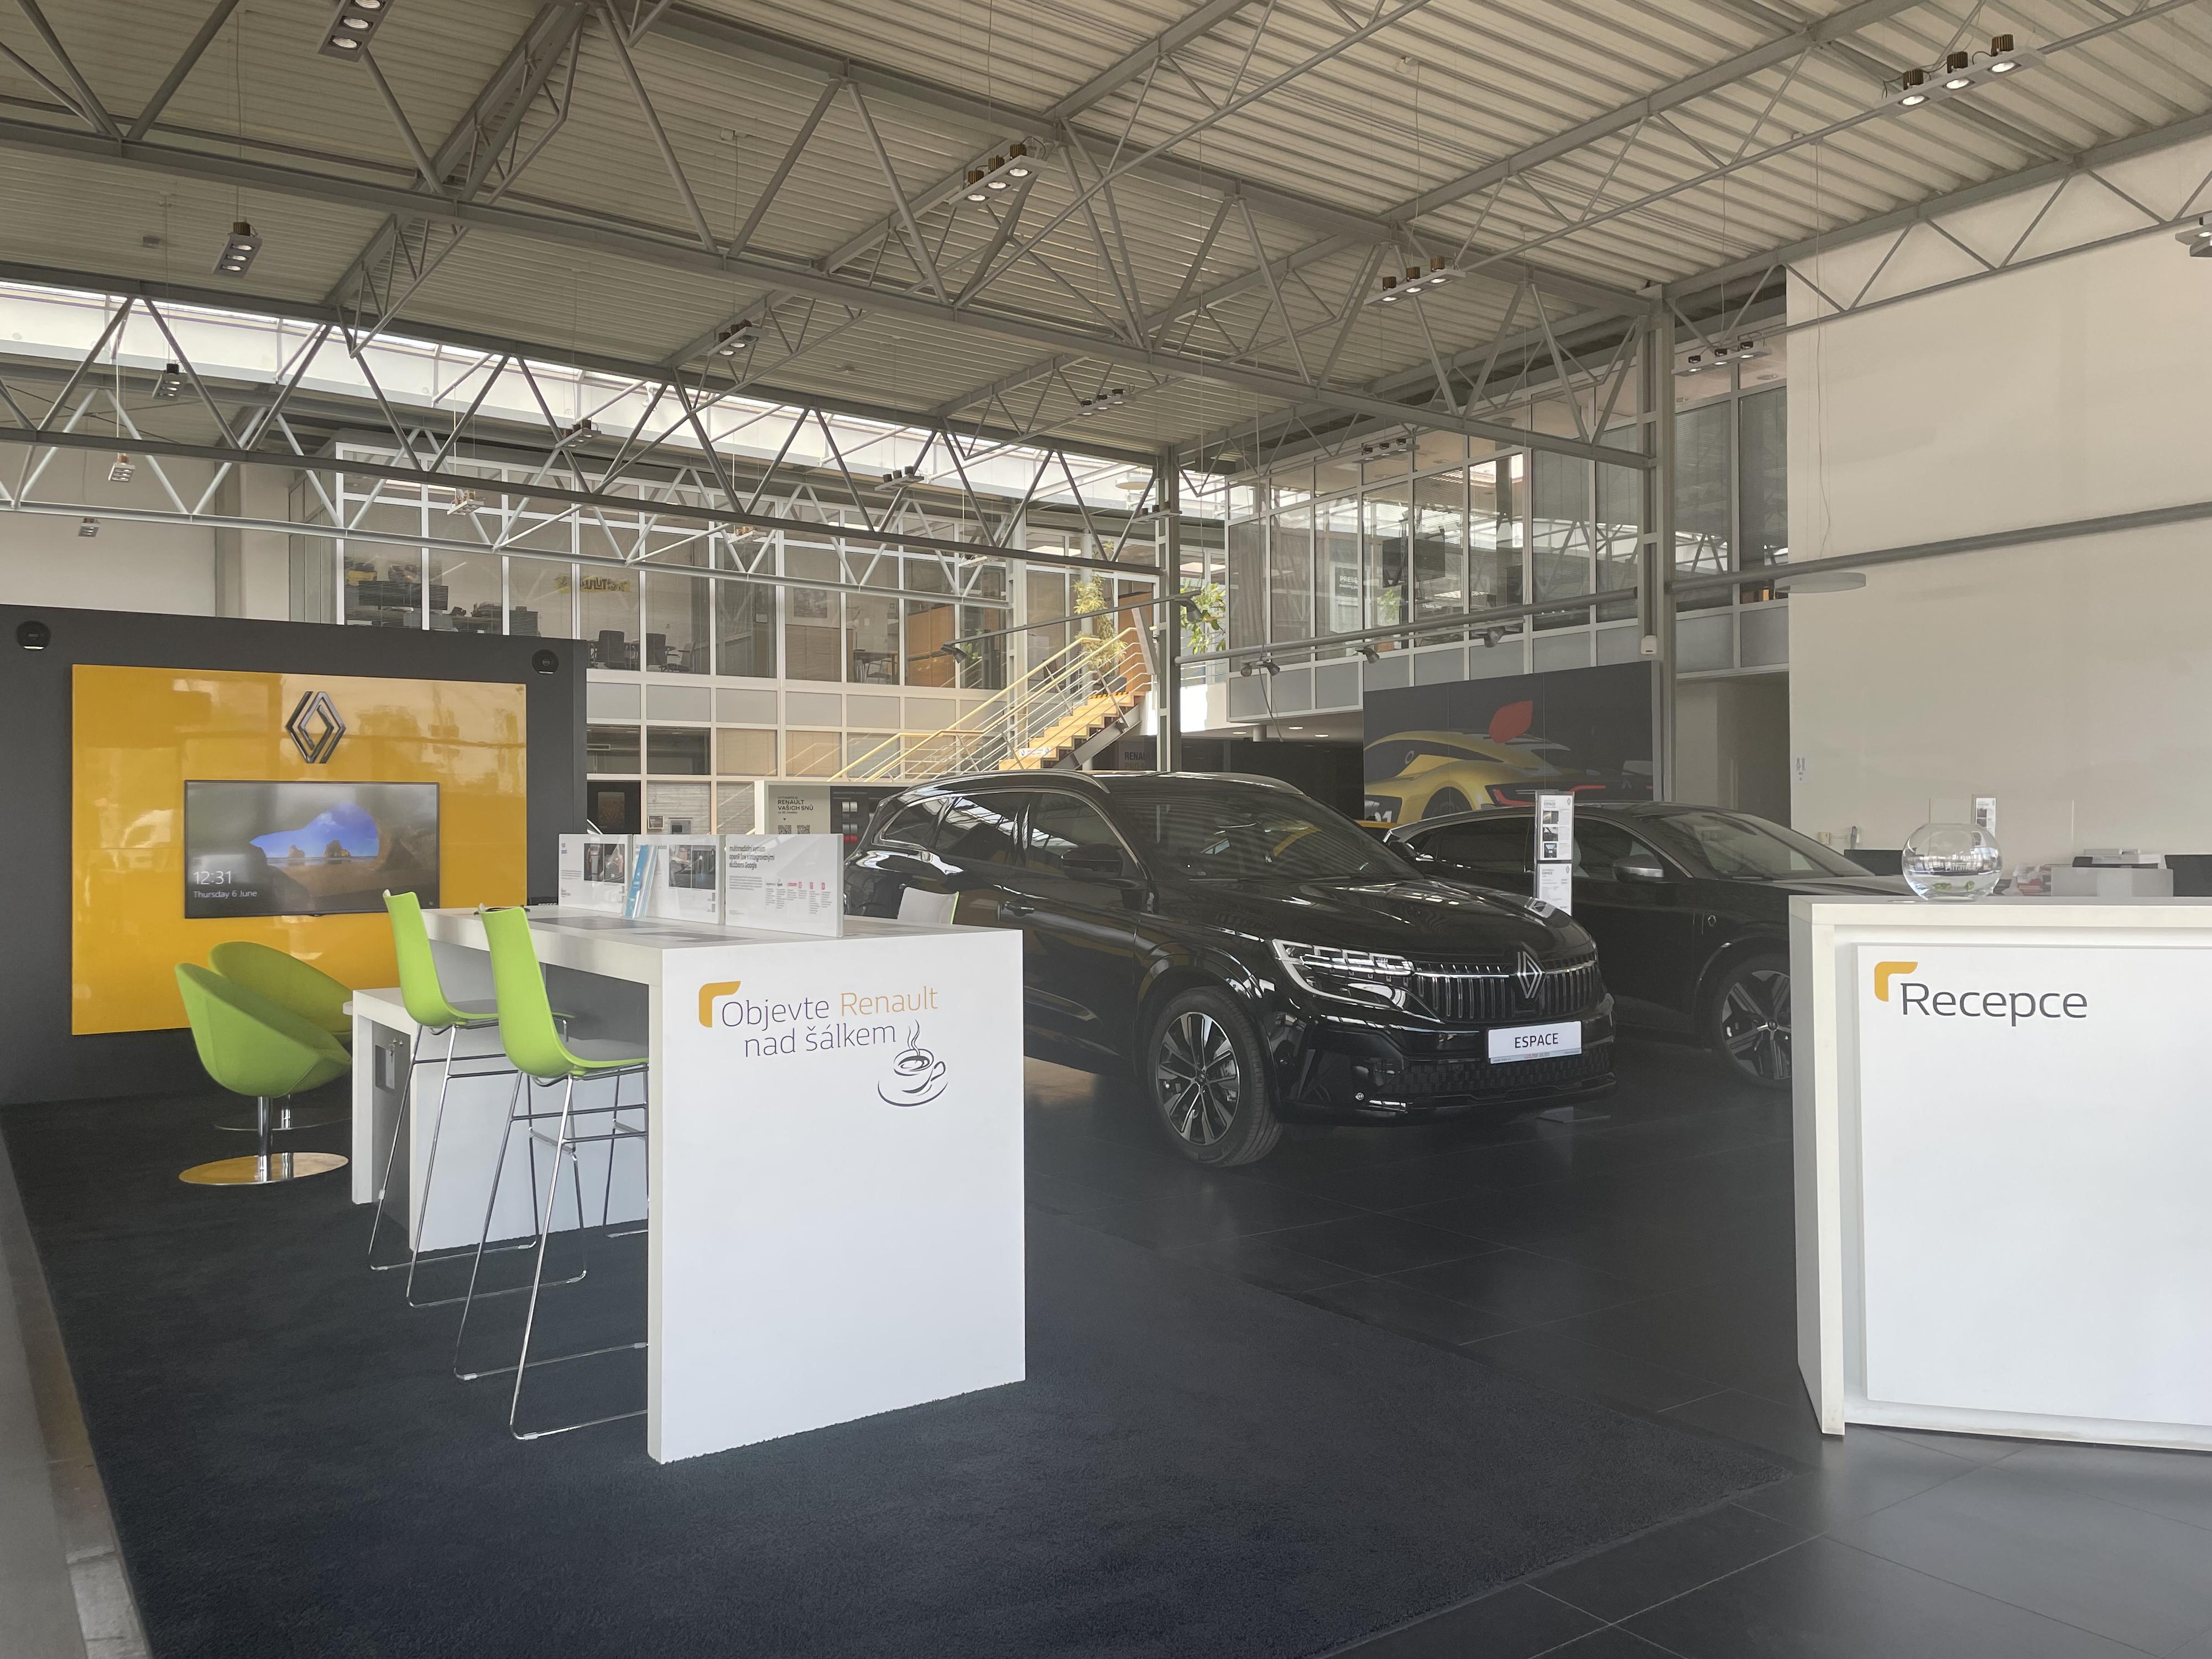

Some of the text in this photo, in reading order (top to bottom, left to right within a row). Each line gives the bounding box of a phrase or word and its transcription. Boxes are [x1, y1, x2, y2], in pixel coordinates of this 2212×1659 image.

[744, 862, 758, 870] Google
[193, 870, 232, 885] 12:31
[193, 890, 231, 899] Thursday
[722, 985, 938, 1031] Objevte Renault
[1900, 983, 2088, 1027] Recepce
[744, 1022, 896, 1058] nad šálkem
[1514, 1032, 1559, 1048] ESPACE
